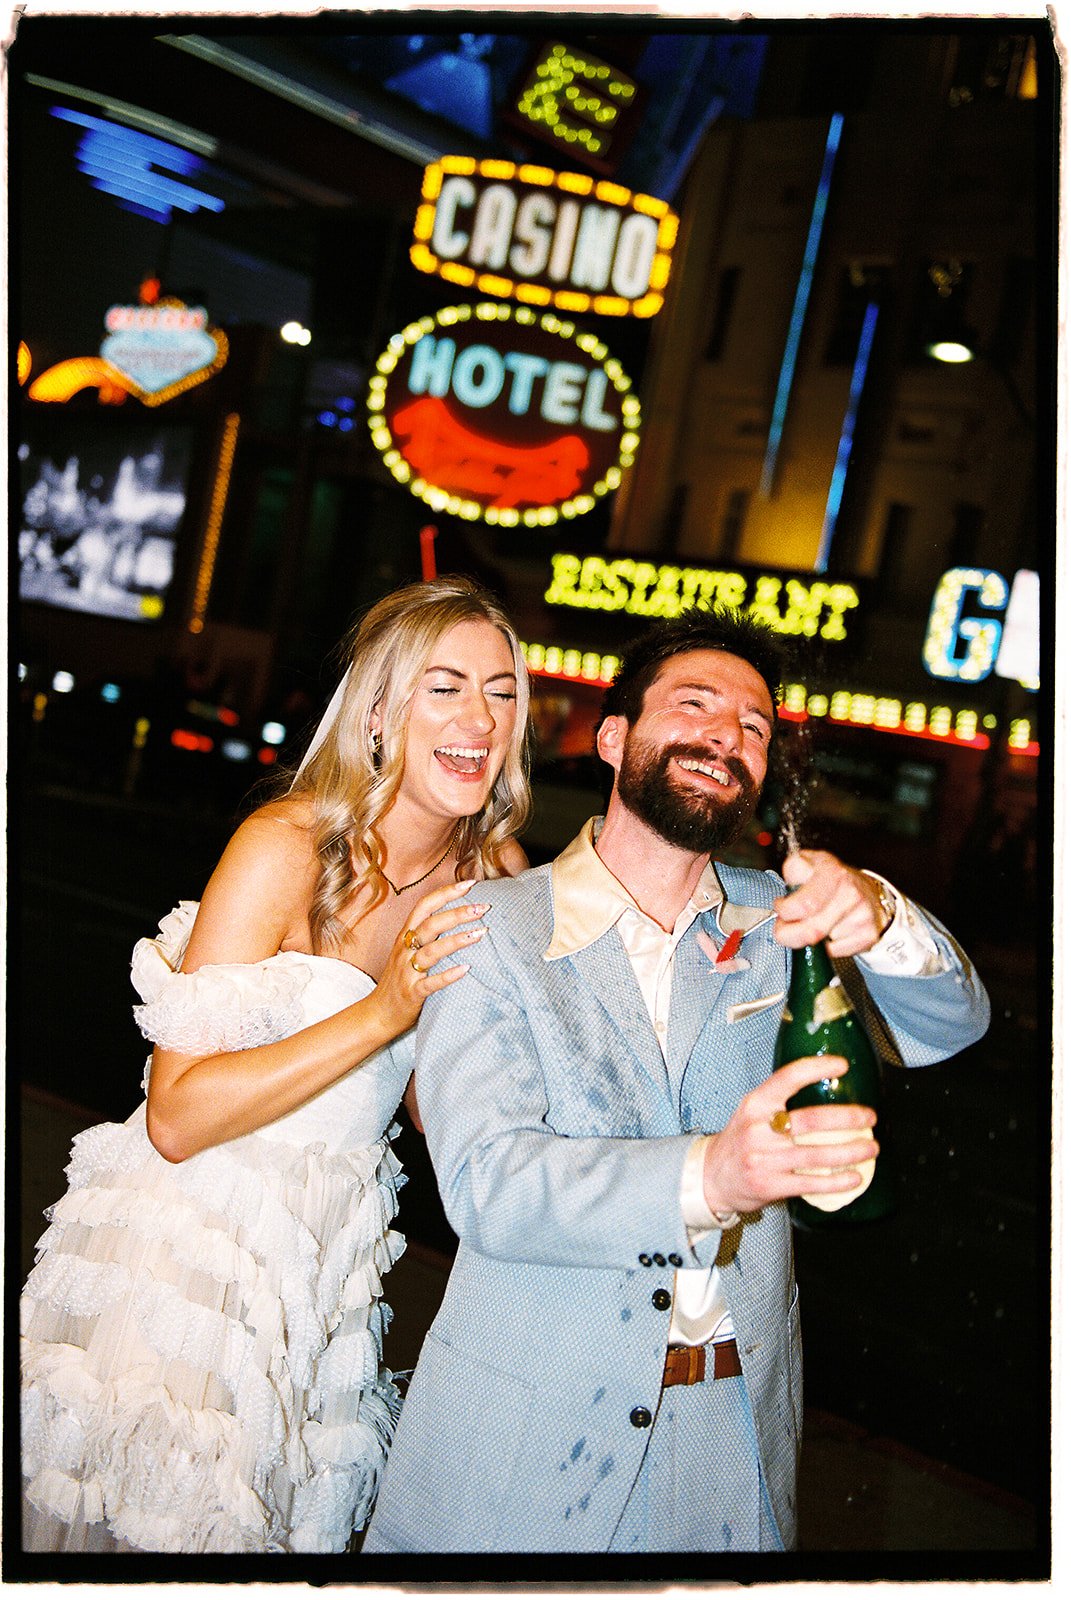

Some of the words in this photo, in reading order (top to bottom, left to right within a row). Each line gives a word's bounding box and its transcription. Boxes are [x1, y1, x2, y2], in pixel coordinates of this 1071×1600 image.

[431, 176, 659, 299] CASINO
[407, 333, 619, 432] HOTEL
[545, 553, 859, 641] RESTAURANT
